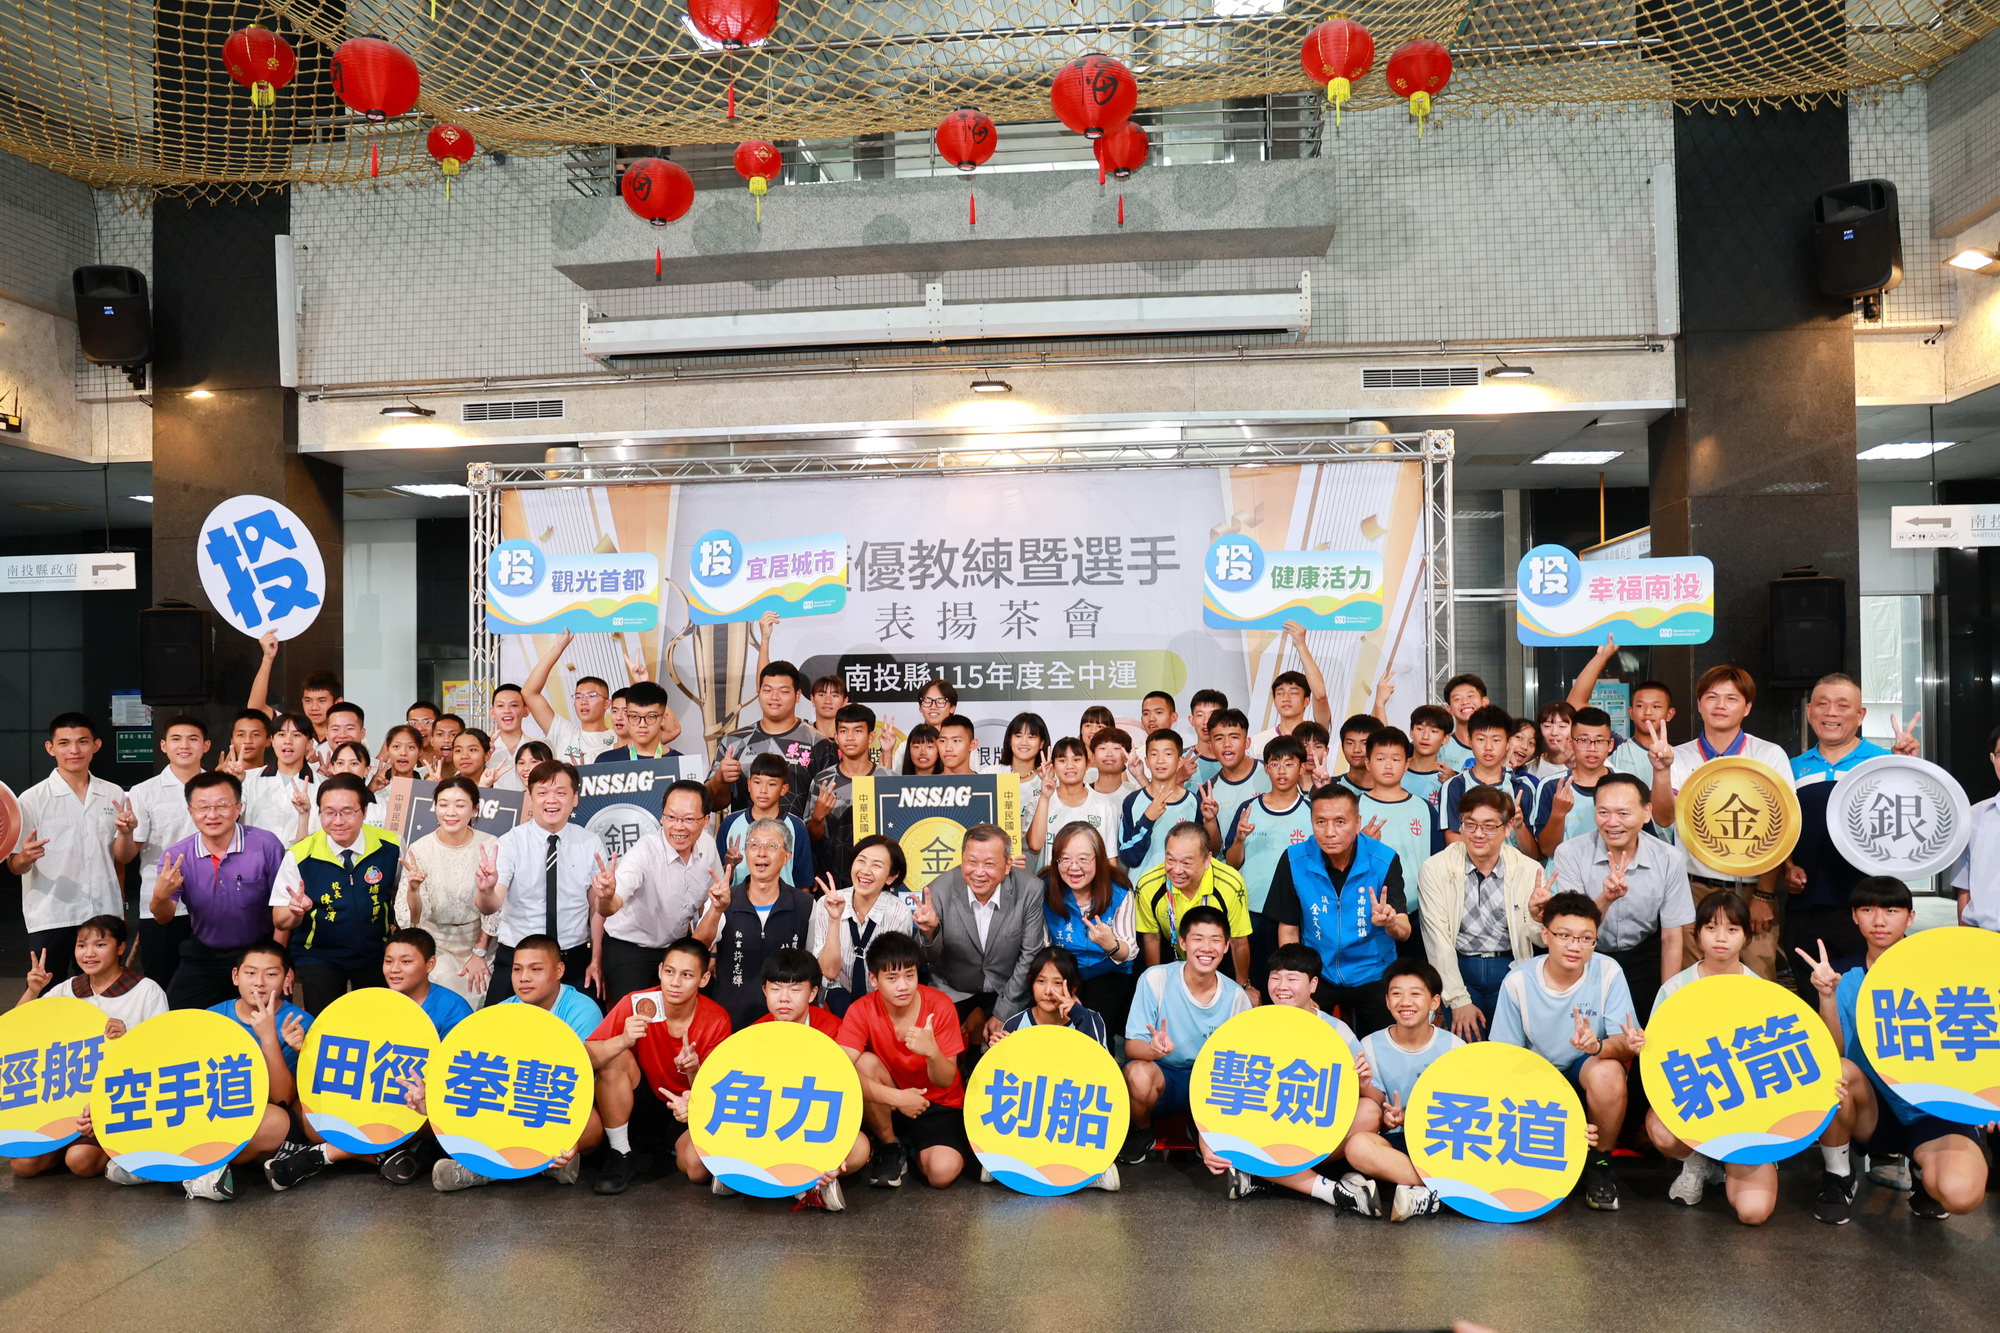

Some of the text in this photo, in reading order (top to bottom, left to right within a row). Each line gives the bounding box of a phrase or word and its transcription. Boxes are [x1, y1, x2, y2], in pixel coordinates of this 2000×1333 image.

[7, 563, 78, 577] 南投縣政府
[205, 508, 321, 630] 投
[498, 549, 535, 587] 投
[698, 539, 733, 578] 投
[746, 549, 837, 582] 宜居城市
[847, 535, 1181, 592] 優教練暨選手
[1215, 545, 1253, 582] 投
[1270, 564, 1373, 592] 健康活力
[1528, 555, 1569, 596] 投
[551, 568, 646, 595] 觀光首都
[1588, 572, 1702, 603] 幸福南投
[875, 598, 1104, 642] 表揚茶會
[844, 659, 1138, 692] 南投縣115年度全中運
[579, 770, 655, 797] NSSAG
[898, 786, 972, 808] NSSAG
[858, 793, 869, 833] 中華民國
[1003, 790, 1014, 831] 中華民國
[1711, 792, 1761, 842] 金
[1868, 792, 1927, 843] 銀
[603, 823, 640, 861] 銀
[919, 836, 956, 875] 金
[1870, 985, 2000, 1063] 跆拳
[311, 1034, 431, 1106] 田徑
[1660, 1012, 1822, 1124] 射箭
[103, 1052, 256, 1136] 空手道
[443, 1049, 580, 1129] 拳擊
[704, 1069, 845, 1144] 角力
[979, 1068, 1114, 1151] 划船
[1204, 1049, 1343, 1129] 擊劍
[1422, 1090, 1570, 1173] 柔道
